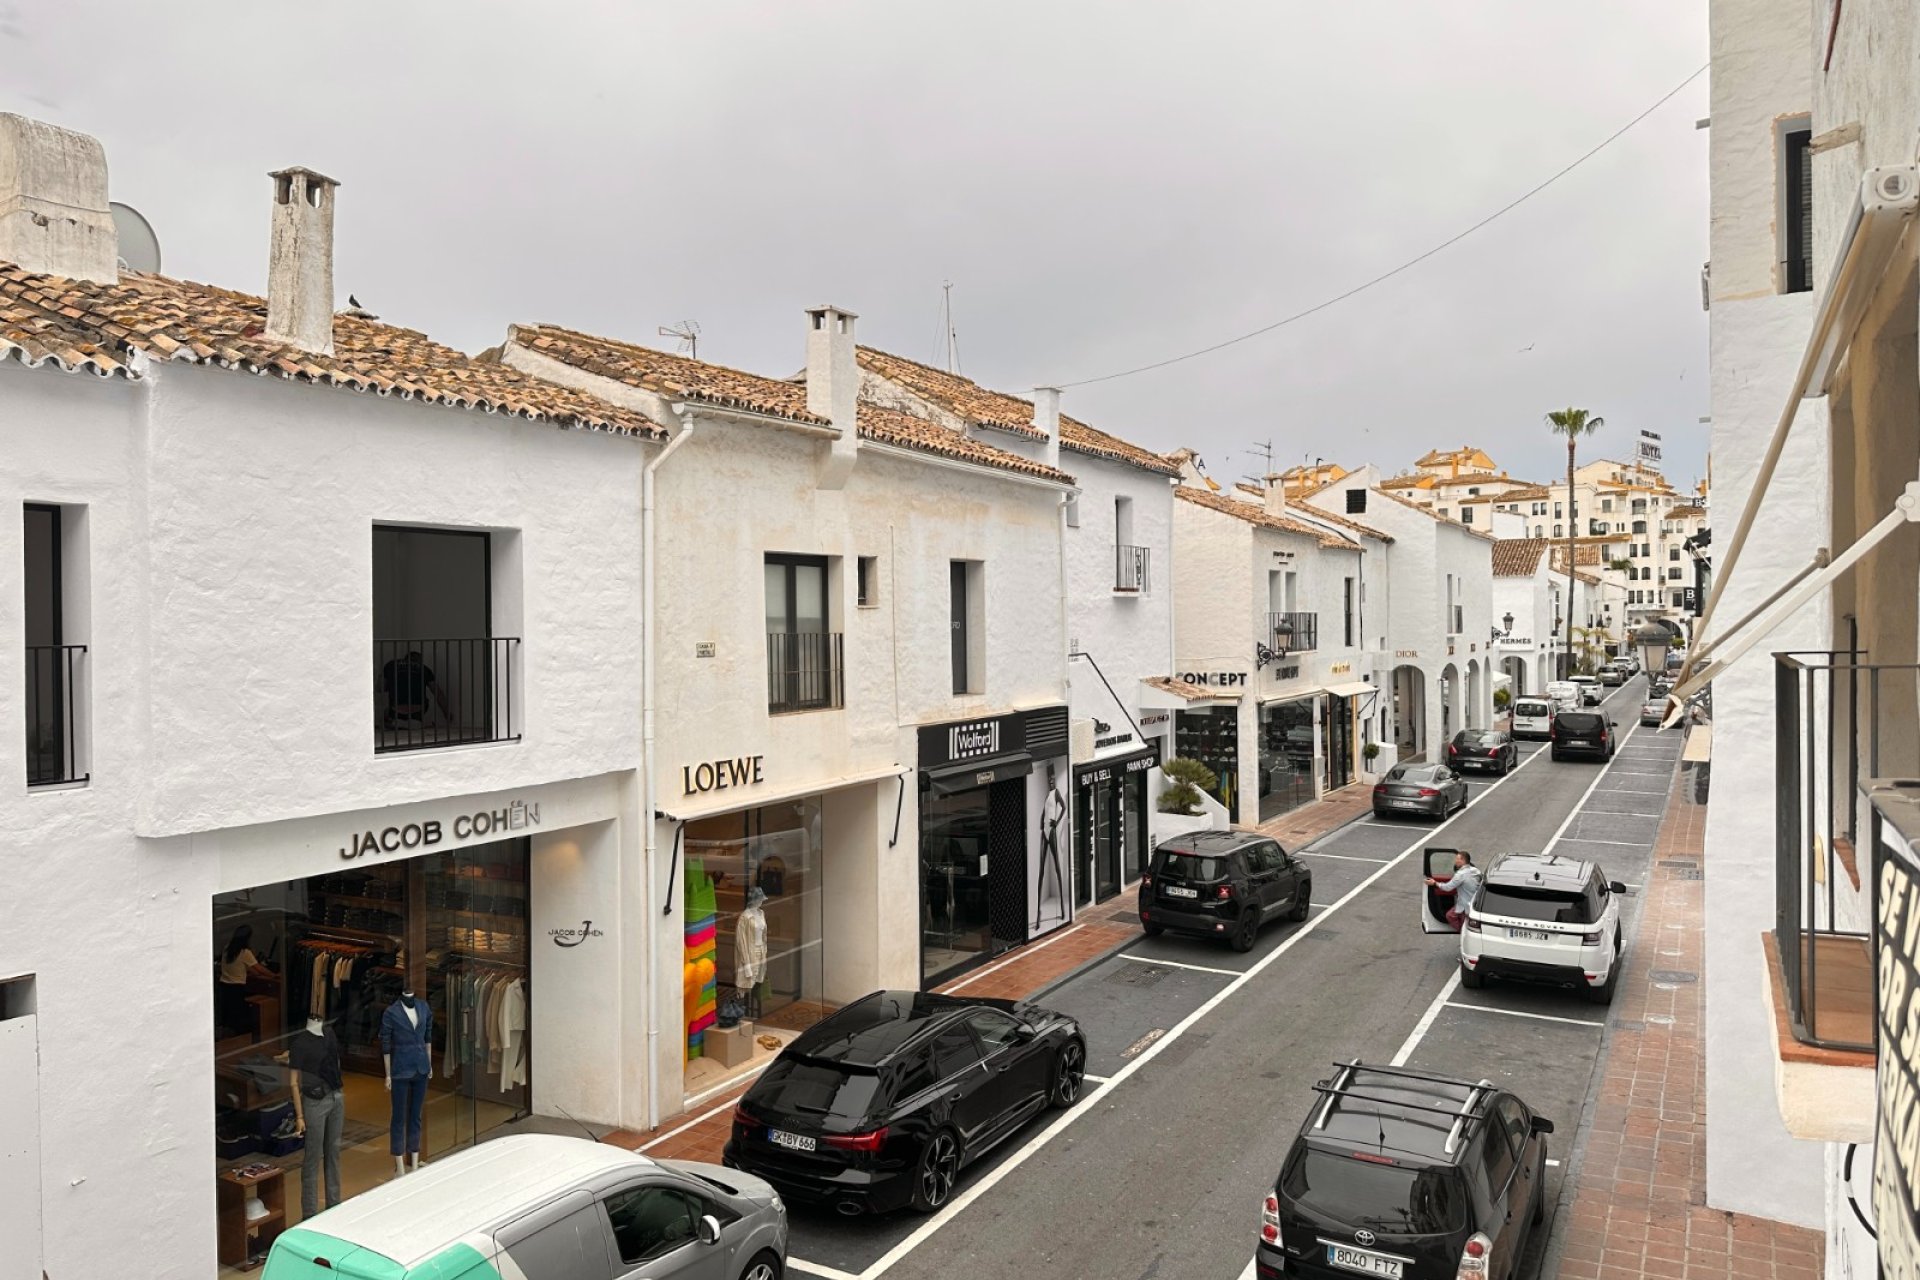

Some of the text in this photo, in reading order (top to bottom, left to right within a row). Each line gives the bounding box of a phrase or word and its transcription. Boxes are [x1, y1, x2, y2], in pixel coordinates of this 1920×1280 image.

[1396, 650, 1418, 659] DIOR
[958, 730, 991, 750] Wolford
[1127, 757, 1154, 773] PAWN SHOP
[683, 755, 764, 796] LOEWE
[1082, 768, 1111, 786] BUY & SELL
[340, 820, 443, 861] JACOB
[799, 1137, 815, 1150] 666
[1337, 1250, 1399, 1276] 8040 FTZ
